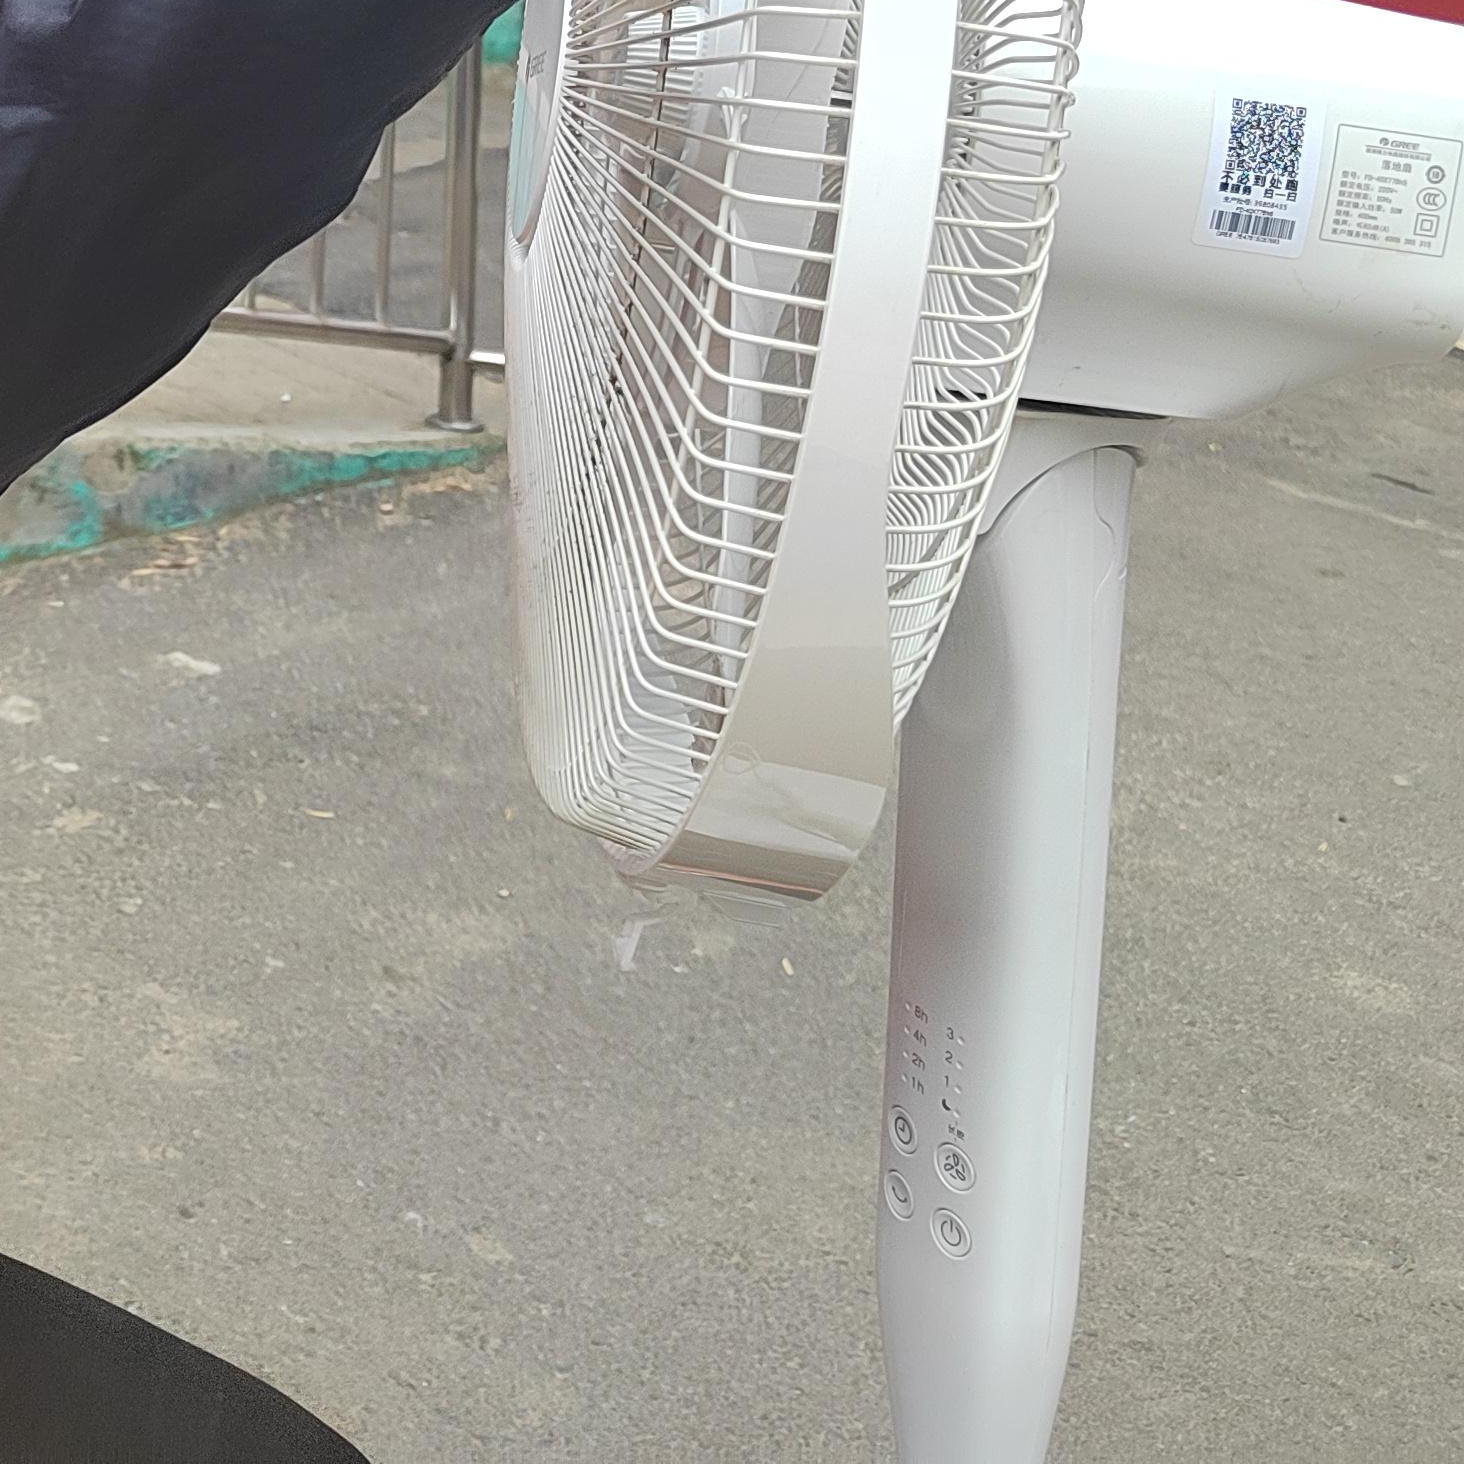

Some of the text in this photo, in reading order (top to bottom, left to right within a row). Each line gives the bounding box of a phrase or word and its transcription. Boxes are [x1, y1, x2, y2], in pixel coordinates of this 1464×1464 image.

[1390, 140, 1421, 150] GREE
[1221, 170, 1299, 192] 不必到处跑
[914, 1005, 929, 1024] 8h
[913, 1029, 927, 1047] 4h
[946, 1027, 954, 1040] 3
[911, 1052, 926, 1072] 2h
[945, 1050, 953, 1064] 2
[911, 1076, 925, 1095] 1h
[944, 1075, 950, 1087] 1
